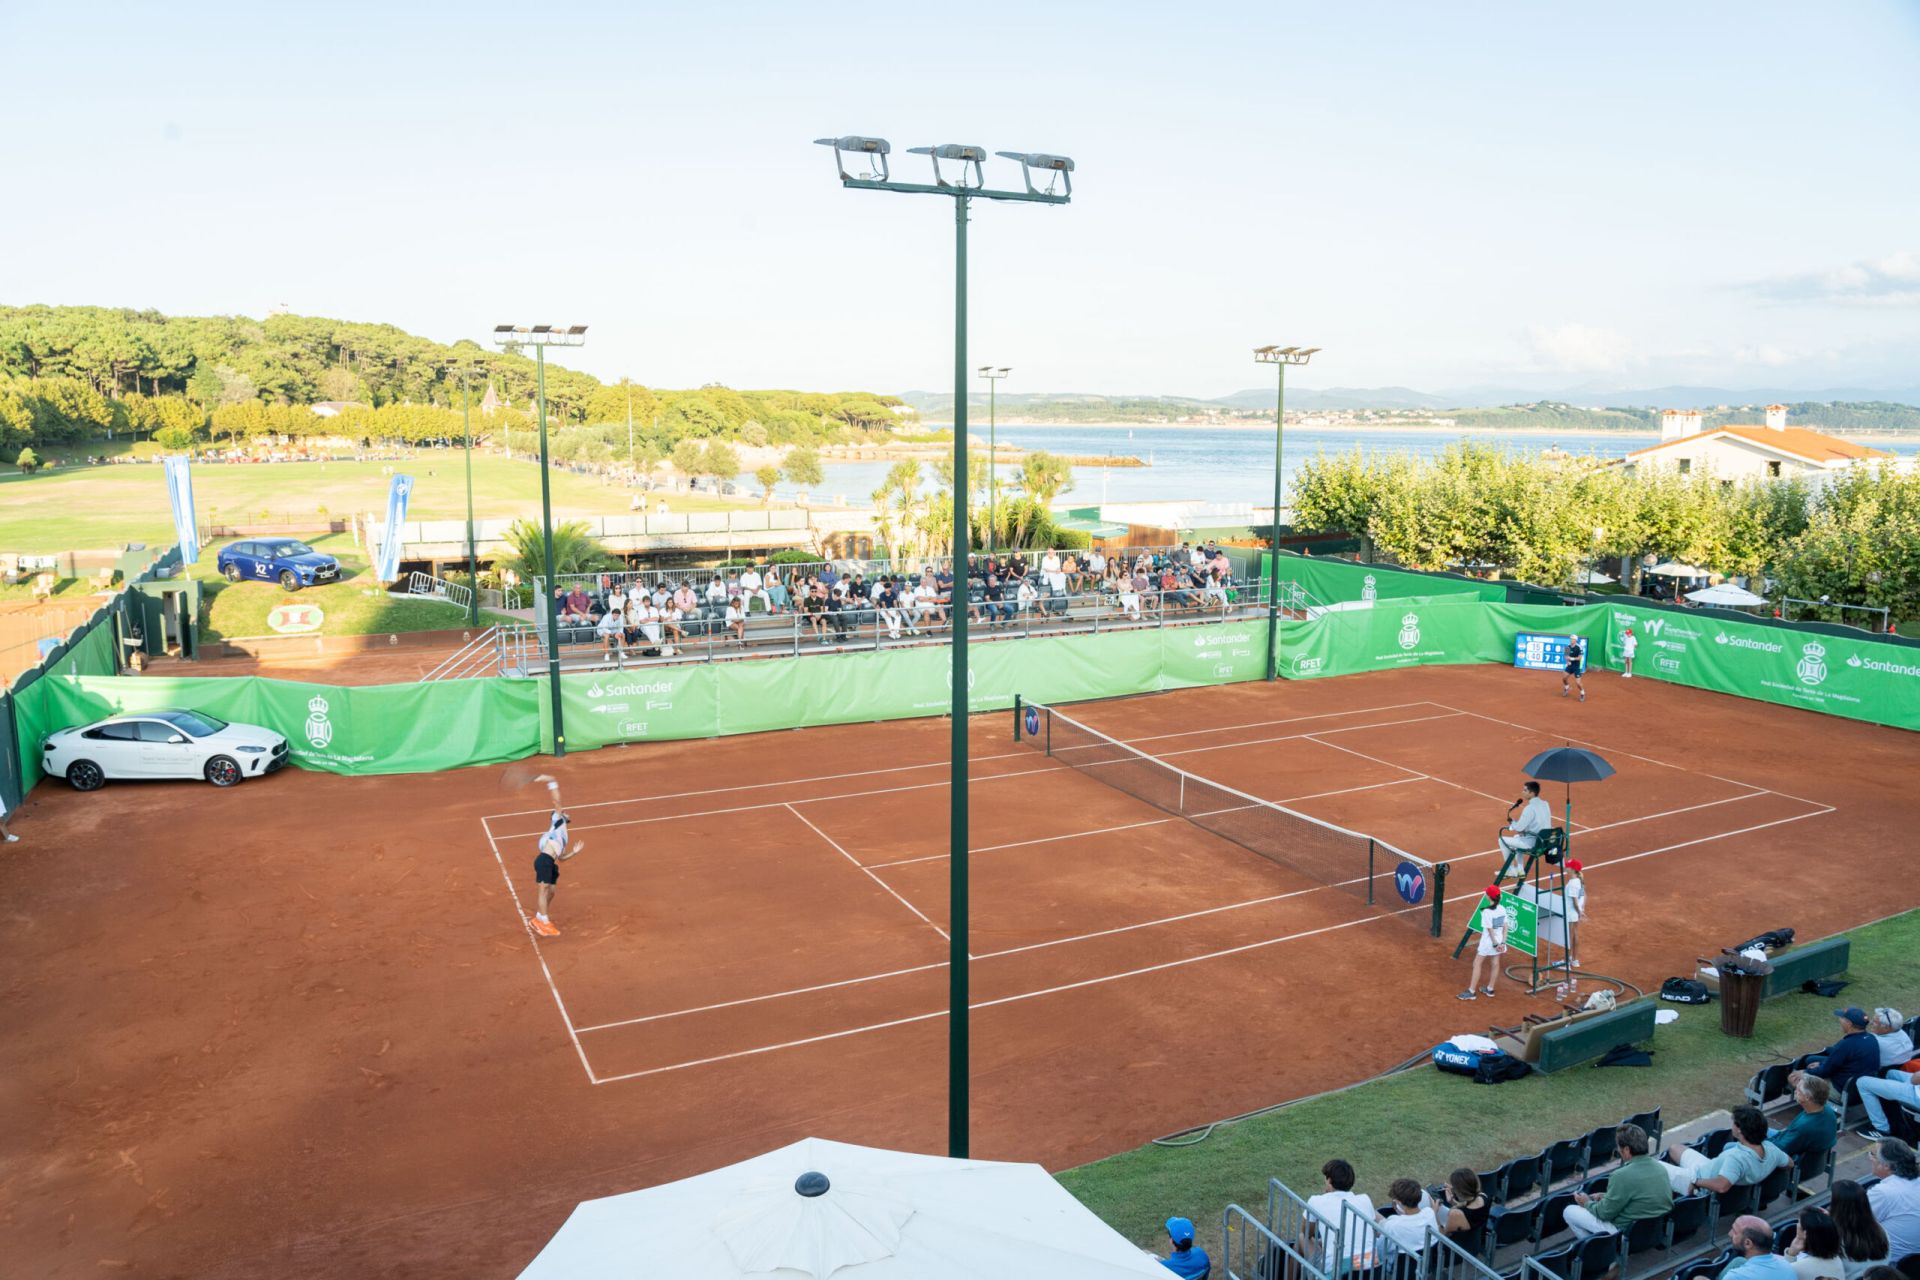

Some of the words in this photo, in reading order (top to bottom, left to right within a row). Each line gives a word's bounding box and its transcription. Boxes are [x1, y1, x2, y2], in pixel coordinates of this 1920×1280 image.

[1206, 633, 1251, 646] Santander
[1729, 635, 1784, 653] Santander
[1300, 657, 1321, 669] RFET
[1660, 658, 1680, 669] RFET
[606, 681, 673, 697] Santander
[626, 722, 649, 731] RFET
[1661, 992, 1691, 1002] HEAD
[1445, 1053, 1470, 1065] YONEX
